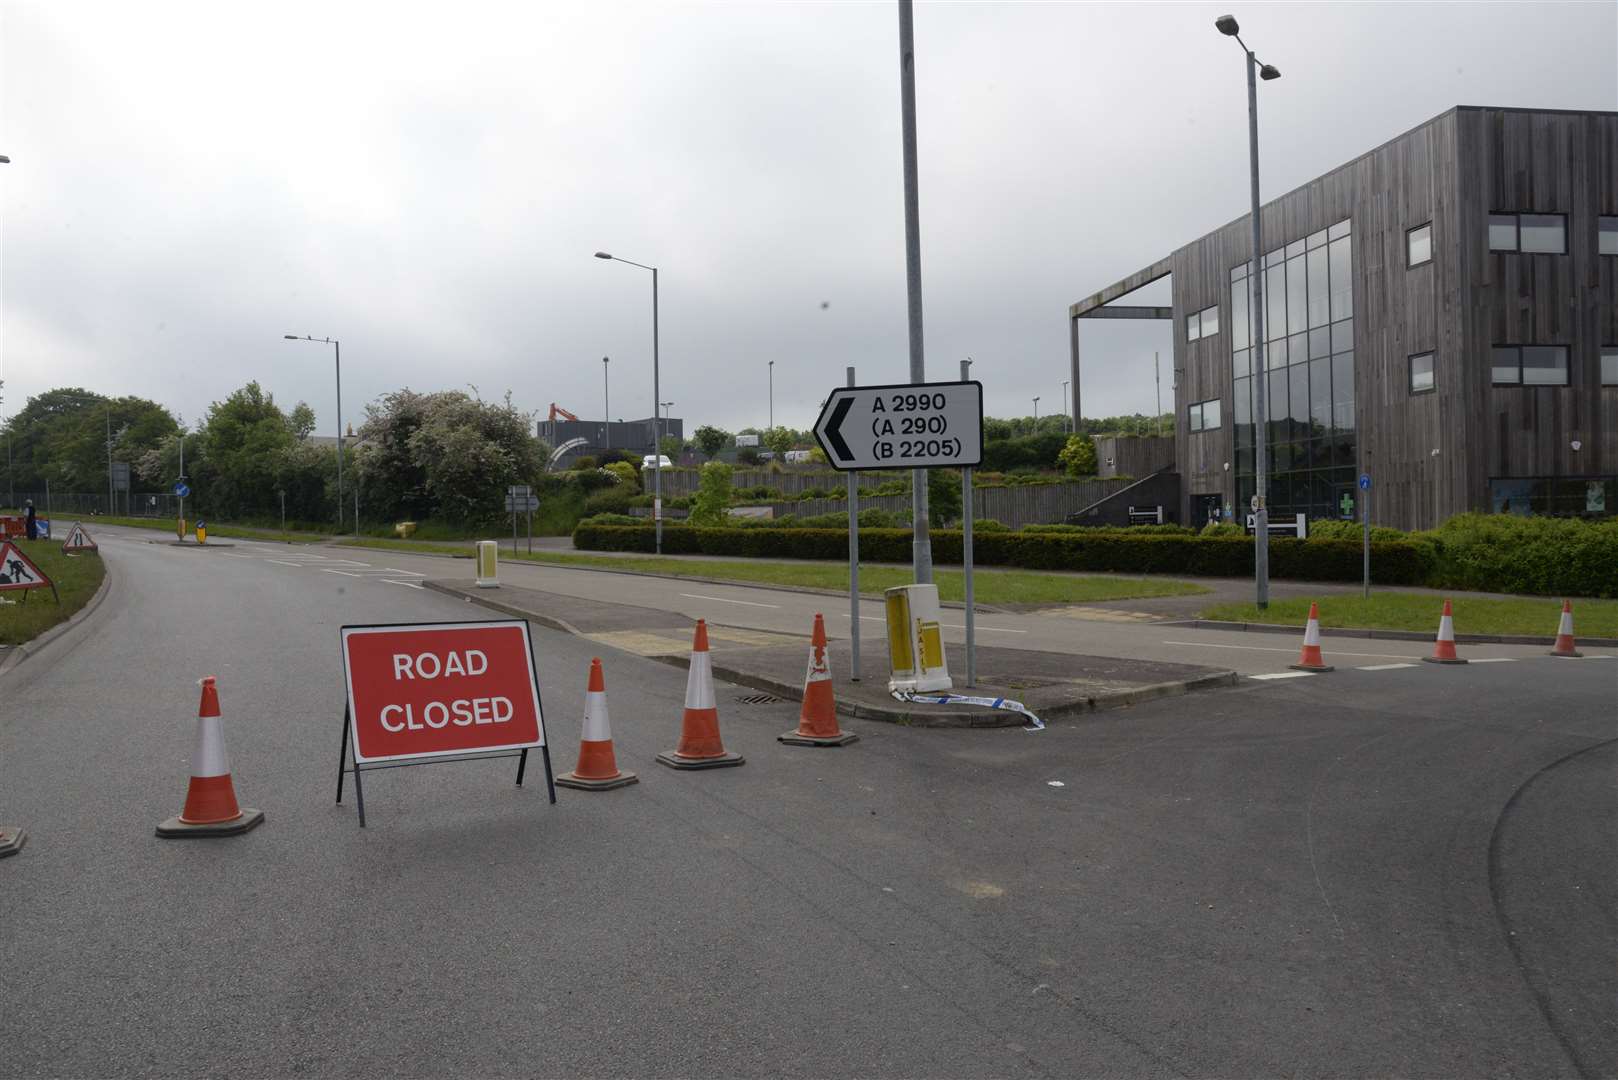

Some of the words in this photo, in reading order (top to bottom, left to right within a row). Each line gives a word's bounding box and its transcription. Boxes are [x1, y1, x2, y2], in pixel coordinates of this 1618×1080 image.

[872, 396, 886, 413] A
[892, 393, 946, 412] 2990
[872, 417, 895, 438] (A
[901, 414, 947, 436] 290)
[873, 440, 894, 461] (B
[900, 437, 961, 459] 2205)
[393, 649, 488, 681] ROAD
[380, 696, 514, 733] CLOSED
